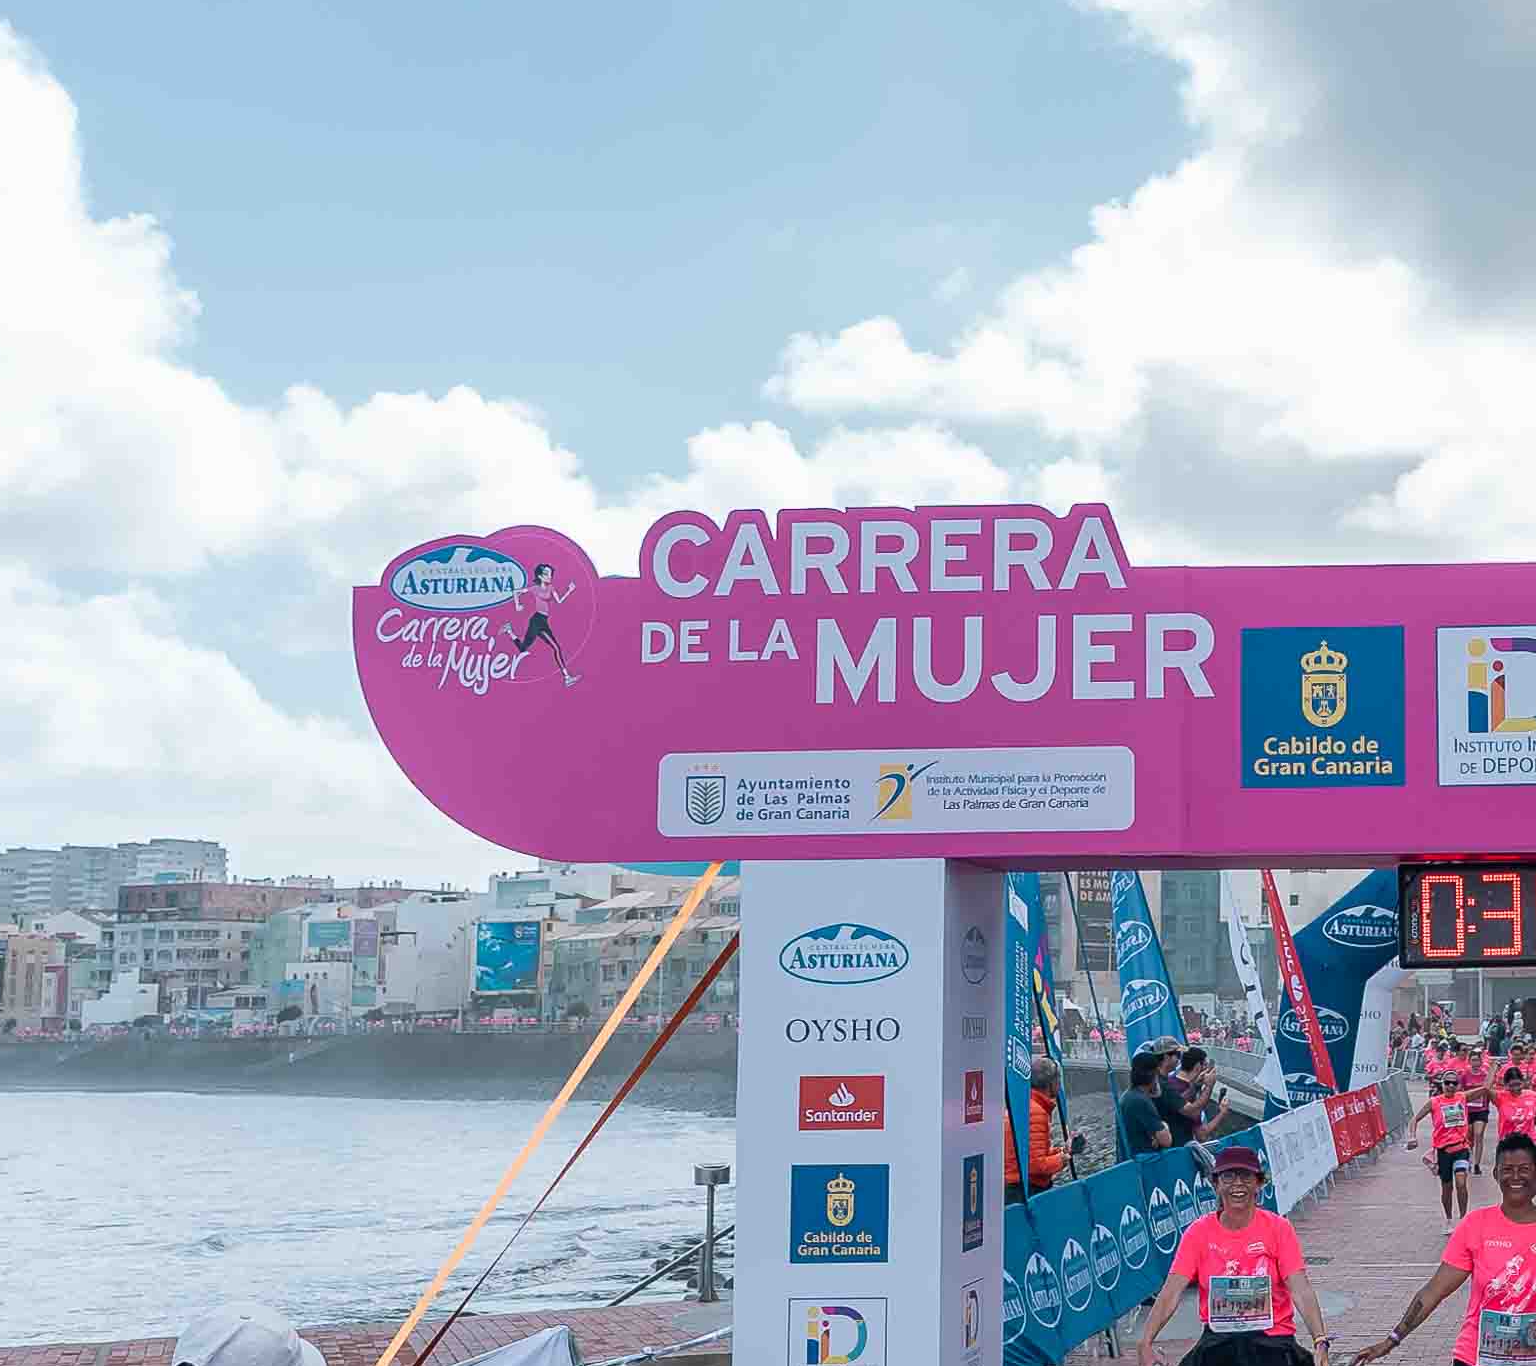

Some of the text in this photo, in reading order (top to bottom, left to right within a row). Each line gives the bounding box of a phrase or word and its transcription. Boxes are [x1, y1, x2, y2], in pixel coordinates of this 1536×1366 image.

[653, 516, 1128, 597] CARRERA
[401, 571, 515, 595] ASTURIANA
[376, 608, 489, 642] Carrera
[401, 638, 530, 695] de la Mujer
[641, 613, 1216, 704] DE LA MUJER
[1264, 735, 1378, 755] Cabildo de
[1453, 736, 1521, 754] INSTITUTO
[1254, 756, 1393, 776] Gran Canaria
[1460, 762, 1477, 774] DE
[736, 776, 851, 793] Ayuntamiento
[926, 772, 1107, 784] Instituto Municipal para la Promoción
[736, 792, 850, 805] de Las Palmas
[927, 787, 940, 796] de
[942, 786, 951, 796] la
[954, 786, 999, 796] Actividad
[1001, 785, 1028, 796] Física
[1029, 788, 1037, 796] y
[1050, 786, 1092, 797] Deporte
[1094, 785, 1106, 794] de
[943, 798, 1089, 810] Las Palmas de Gran Canaria
[736, 807, 850, 820] de Gran Canaria
[789, 947, 900, 969] ASTURIANA
[785, 1018, 901, 1042] OYSHO
[805, 1109, 878, 1123] Santander
[804, 1232, 872, 1244] Cabildo de
[798, 1244, 881, 1257] Gran Canaria
